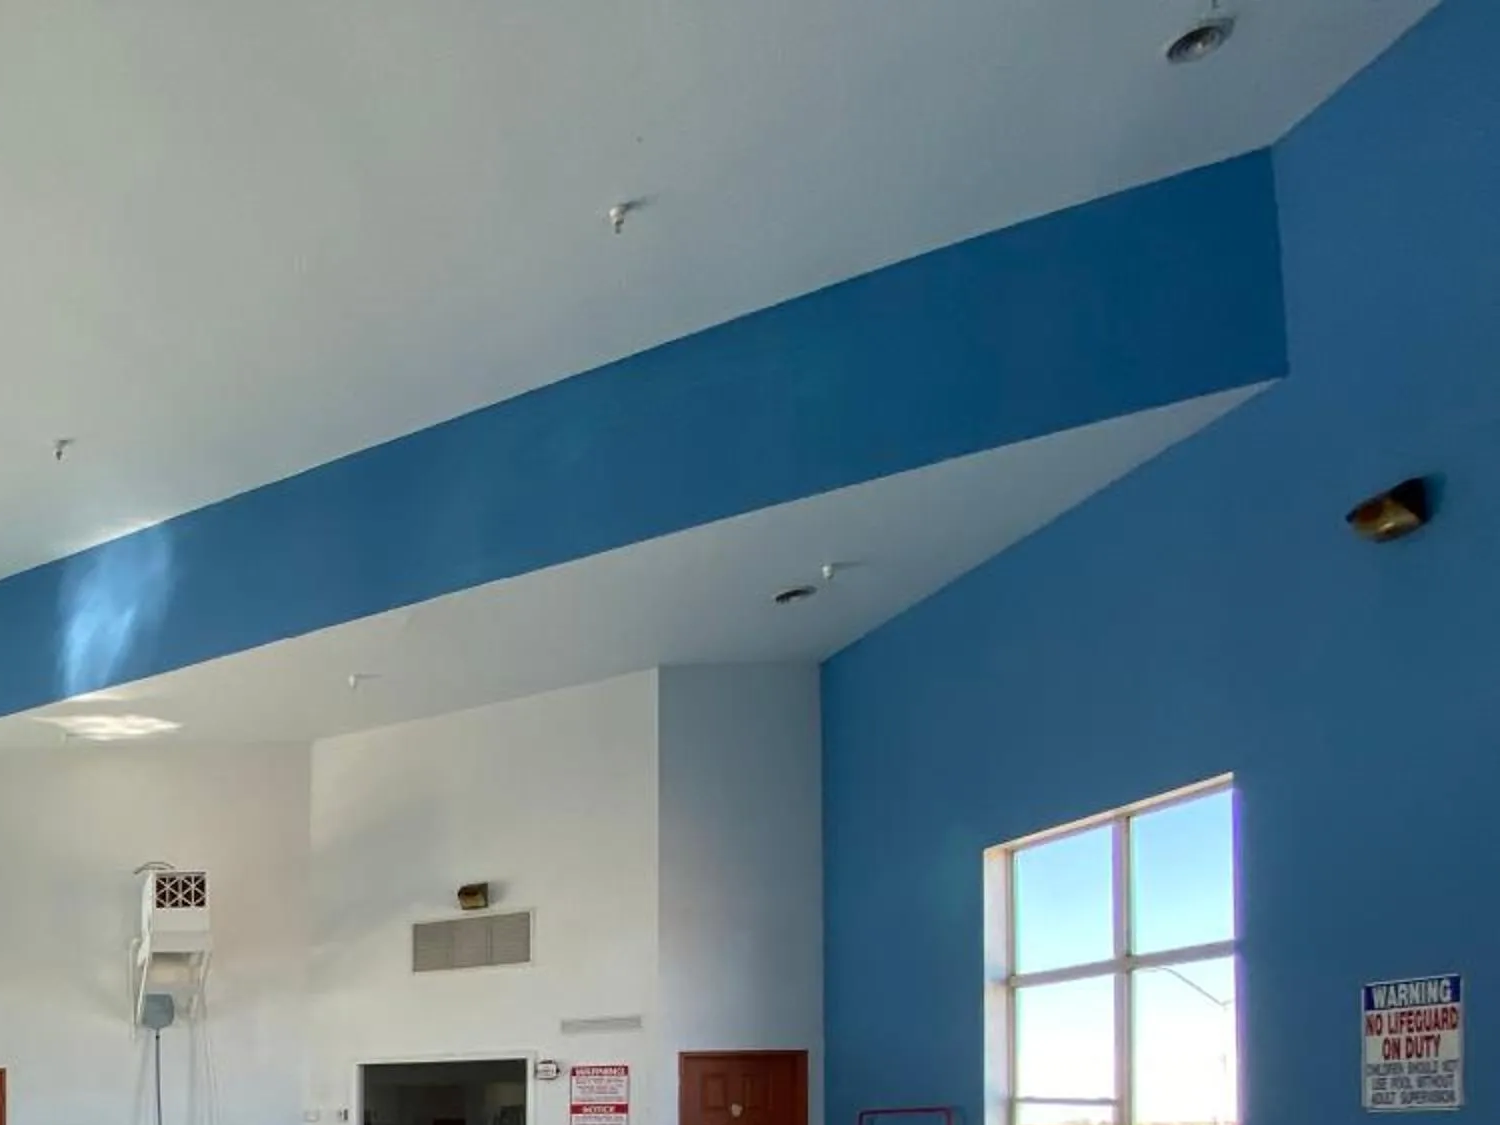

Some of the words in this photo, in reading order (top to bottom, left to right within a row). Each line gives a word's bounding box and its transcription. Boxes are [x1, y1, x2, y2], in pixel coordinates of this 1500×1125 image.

[1372, 979, 1453, 1009] WARNING
[1366, 1013, 1383, 1037] NO
[1387, 1007, 1459, 1035] LIFEGUARD
[1382, 1037, 1401, 1060] ON
[1404, 1034, 1441, 1060] DUTY
